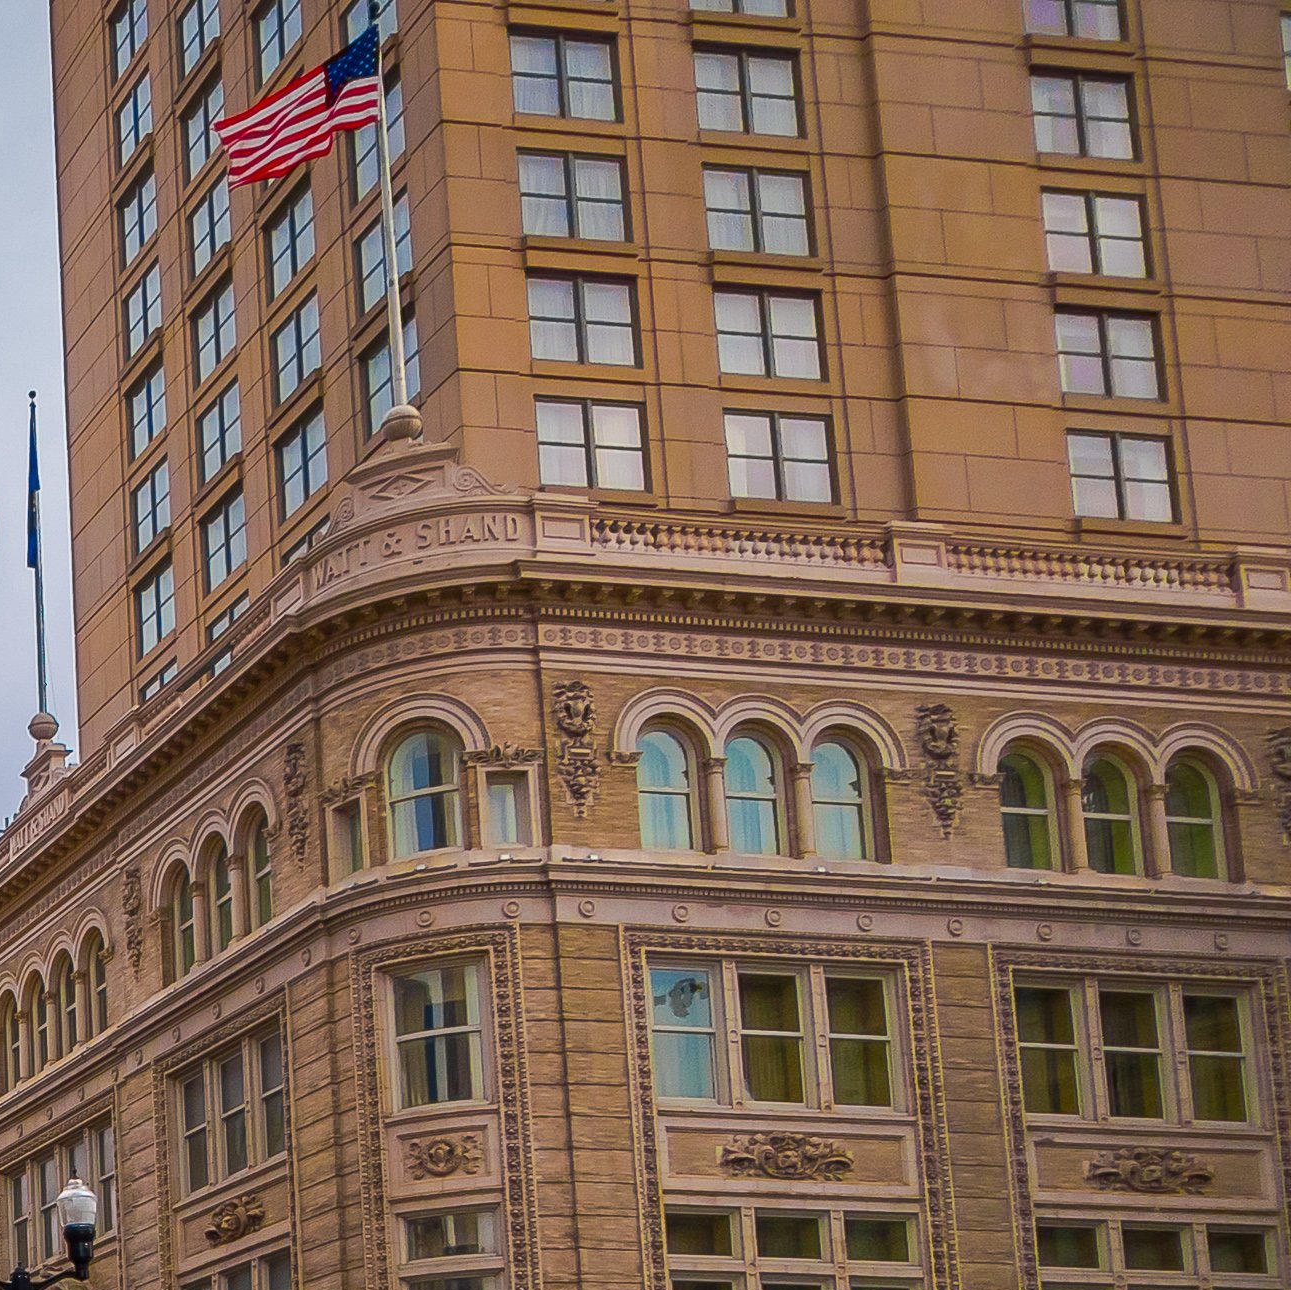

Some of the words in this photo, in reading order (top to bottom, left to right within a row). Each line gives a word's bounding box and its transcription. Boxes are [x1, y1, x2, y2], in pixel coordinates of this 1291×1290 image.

[312, 539, 371, 590] WATT
[382, 532, 403, 558] &
[417, 514, 519, 549] SHAND
